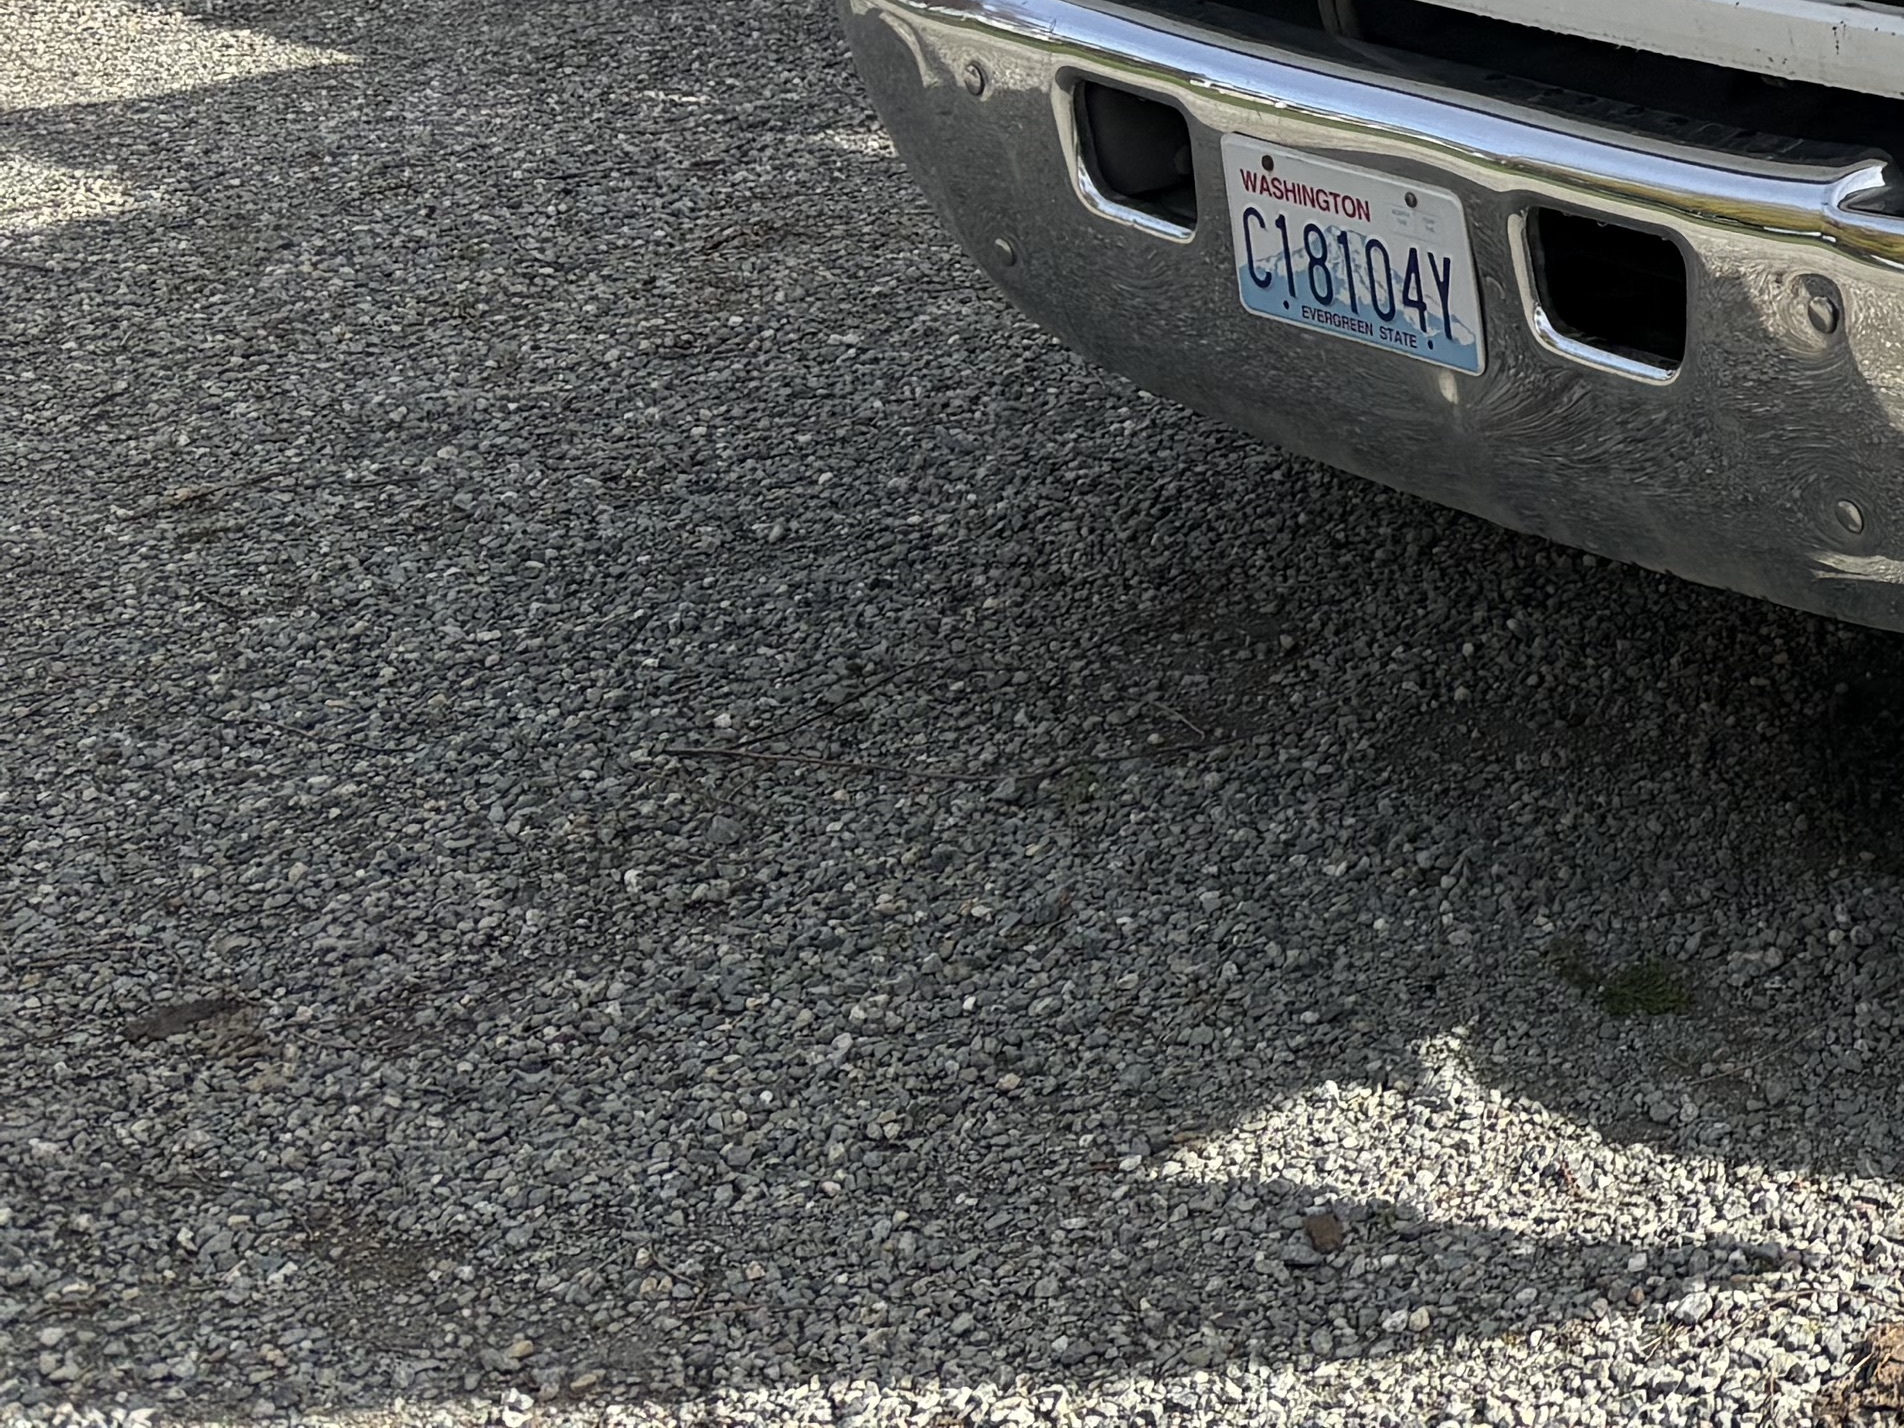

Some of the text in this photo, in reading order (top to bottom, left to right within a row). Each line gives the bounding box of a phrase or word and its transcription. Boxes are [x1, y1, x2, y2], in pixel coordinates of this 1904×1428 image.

[1239, 168, 1371, 222] WASHINGTON
[1242, 206, 1453, 341] C18104Y
[1301, 305, 1418, 349] EVERGREEN STATE
